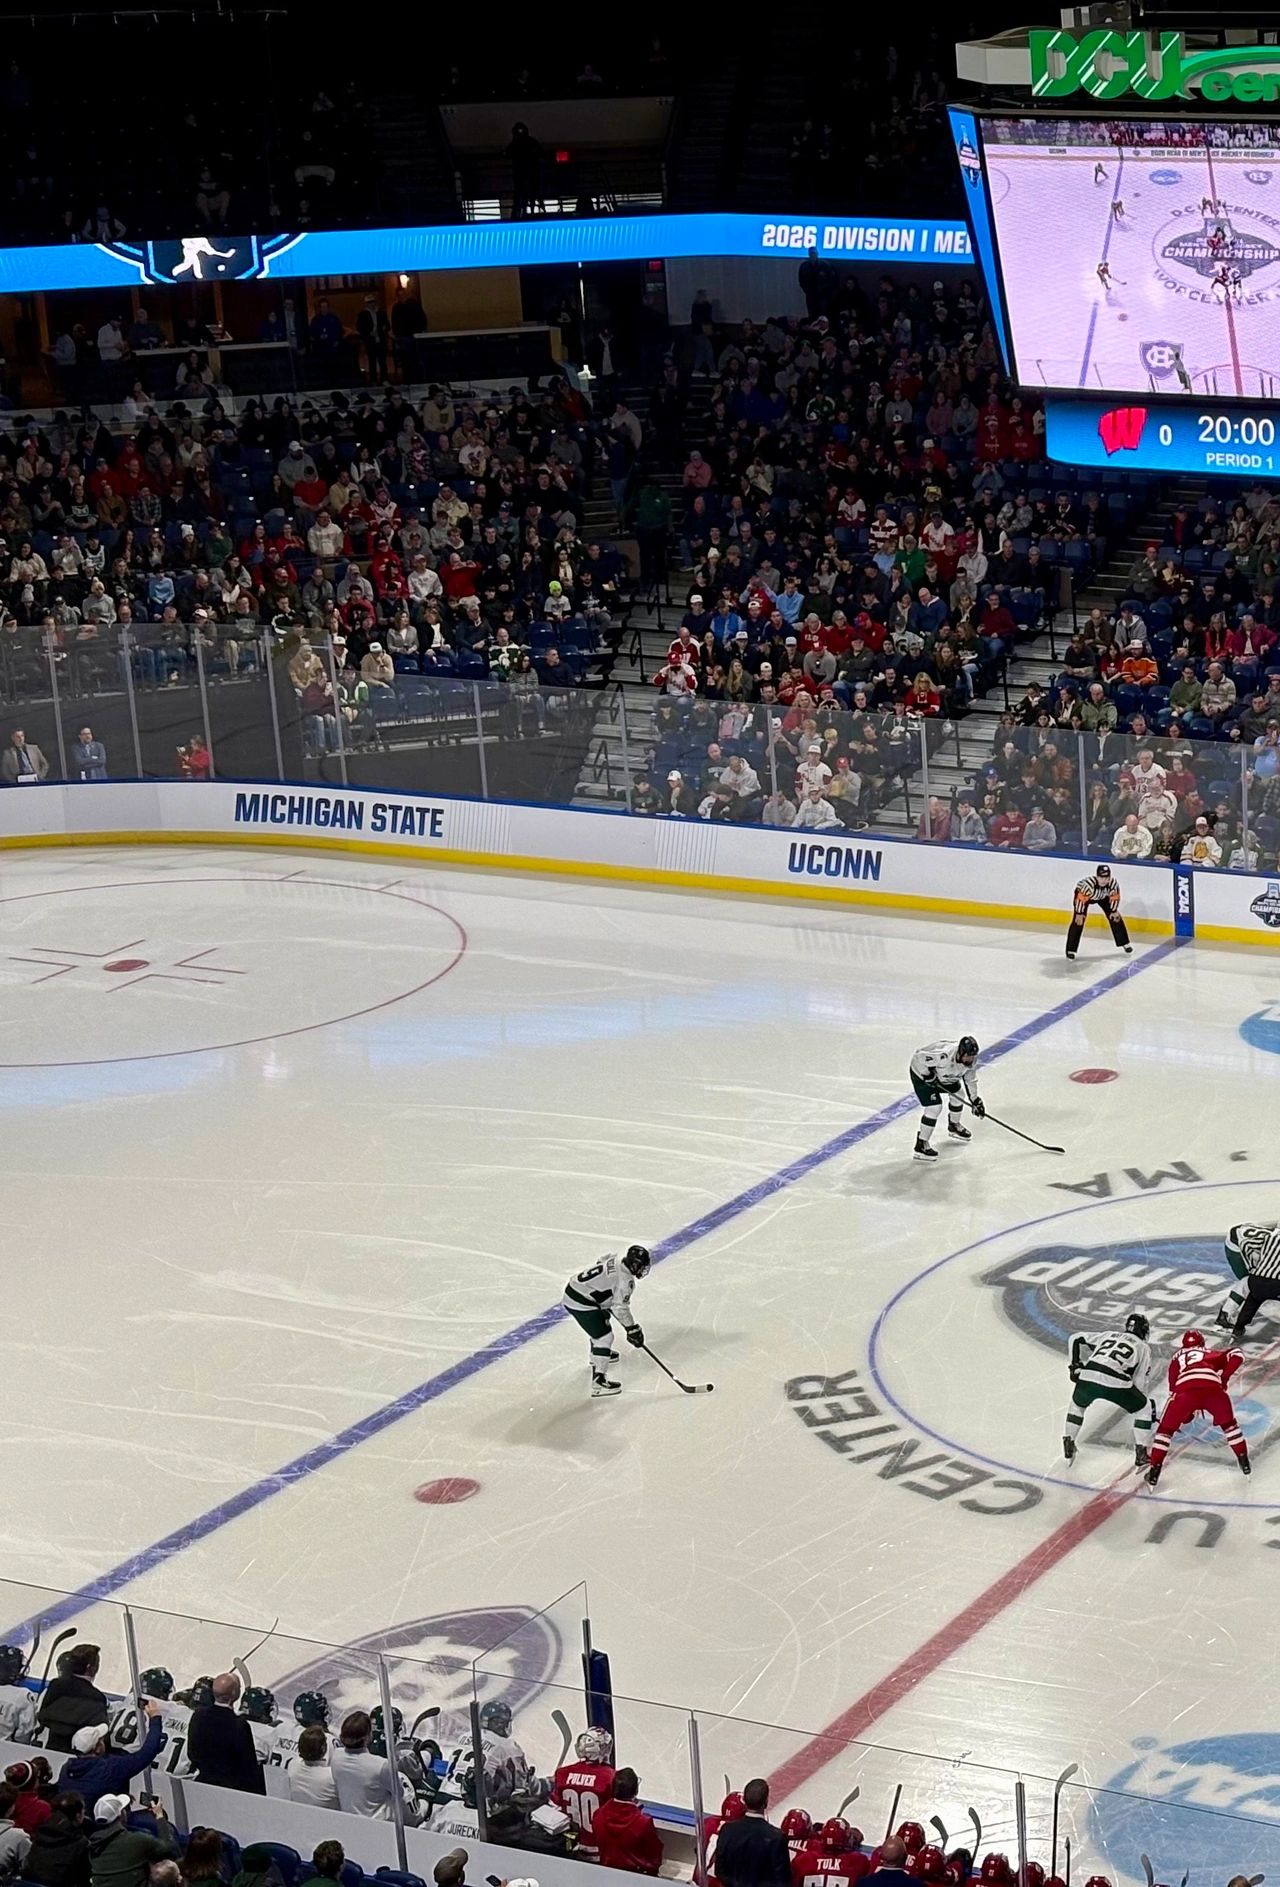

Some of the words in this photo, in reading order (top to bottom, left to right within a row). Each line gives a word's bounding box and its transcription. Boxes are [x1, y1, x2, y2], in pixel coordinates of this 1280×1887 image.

[1029, 30, 1184, 98] DCU
[762, 224, 817, 248] 2026
[823, 226, 915, 252] DIVISION
[920, 230, 928, 252] I
[1098, 407, 1147, 457] W
[1159, 425, 1172, 446] 0
[1198, 415, 1275, 446] 20:00
[1206, 453, 1262, 468] PERIOD
[1267, 457, 1273, 469] 1
[235, 793, 364, 830] MICHIGAN
[370, 803, 444, 837] STATE
[788, 842, 882, 881] UCONN
[1178, 876, 1190, 914] NCAA
[1048, 1160, 1206, 1199] MA
[1093, 1339, 1134, 1365] 22
[1179, 1350, 1205, 1372] 13
[784, 1369, 1045, 1516] CENTER
[111, 1708, 139, 1745] 18
[566, 1772, 597, 1787] PULVER
[562, 1788, 600, 1833] 30
[816, 1858, 842, 1871] TULK
